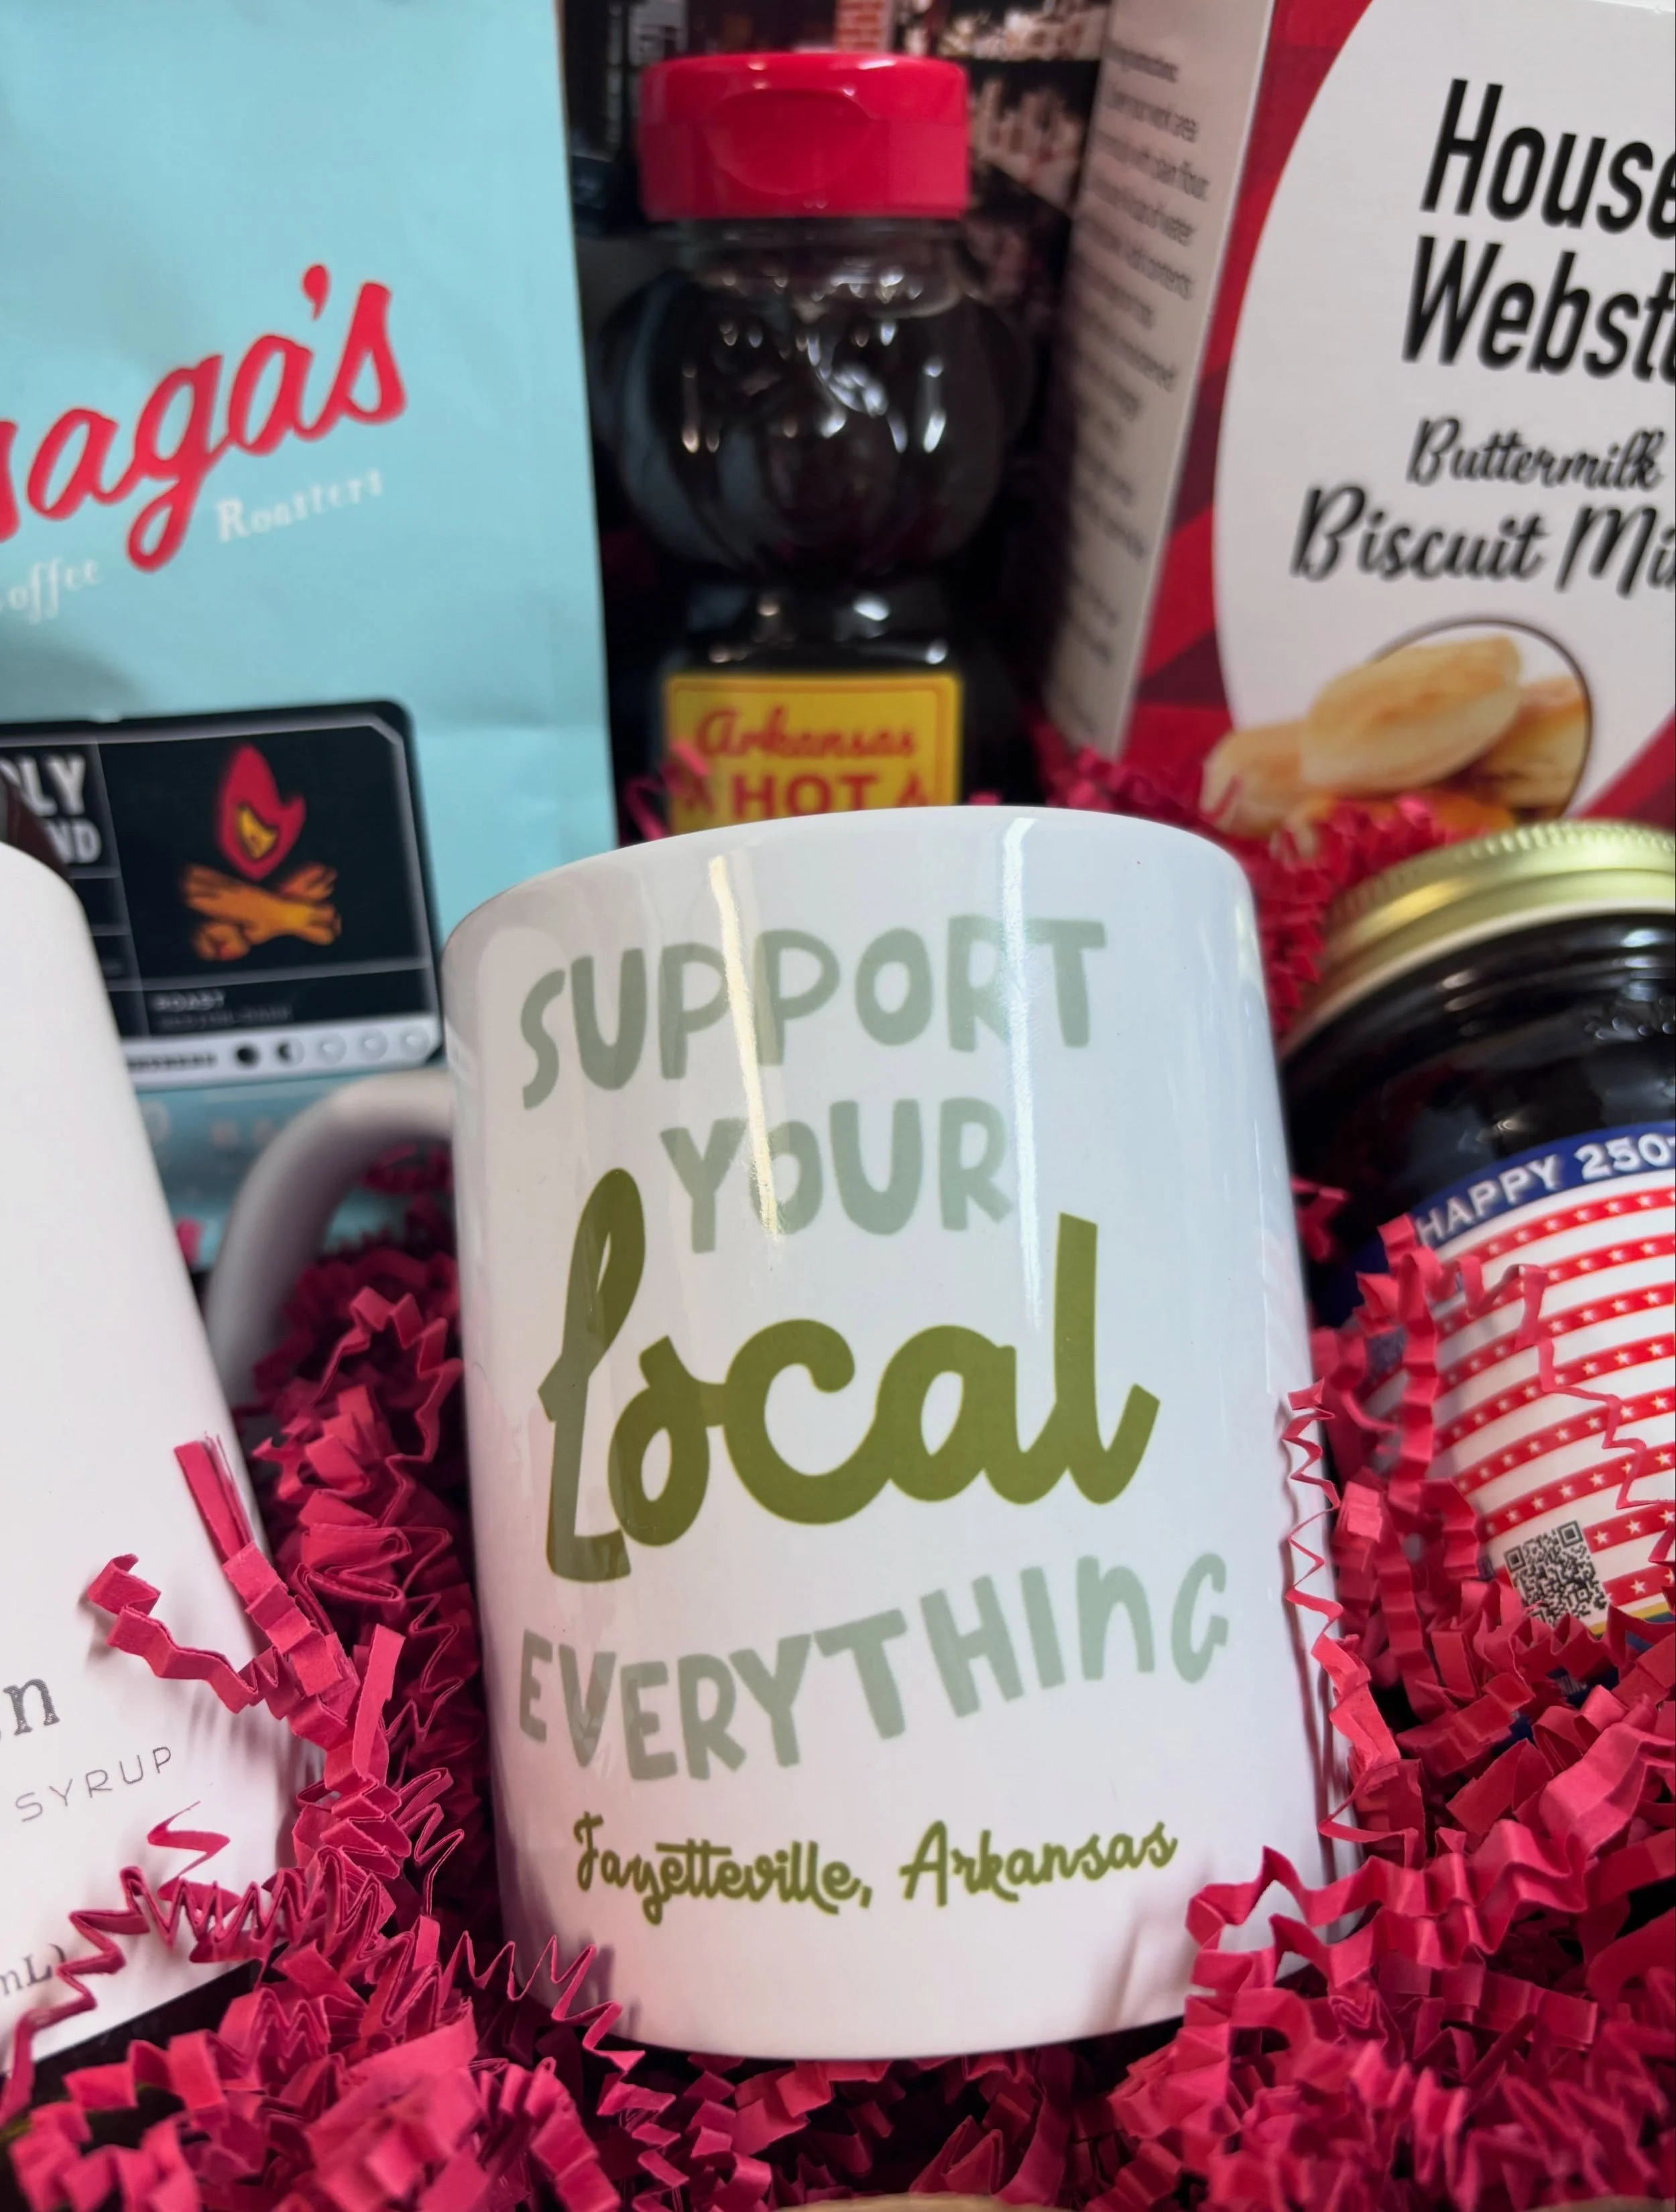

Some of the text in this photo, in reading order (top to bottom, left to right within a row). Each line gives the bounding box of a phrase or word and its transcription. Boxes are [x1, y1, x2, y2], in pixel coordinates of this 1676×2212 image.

[1402, 235, 1675, 386] Webst
[0, 263, 408, 573] aga's
[1405, 416, 1667, 493] Buttermilk
[0, 555, 103, 625] offee
[1289, 483, 1675, 599] Biscuit Mi
[696, 704, 914, 757] Arkansas
[730, 772, 880, 819] HOT
[520, 914, 1106, 1109] SUPPORT
[660, 1097, 1014, 1253] YOUR
[1415, 1154, 1559, 1245] HAPPY
[537, 1167, 1160, 1583] Local
[15, 1745, 172, 1823] SYRUP
[573, 1811, 1178, 1925] Fayetteville, Arkansas
